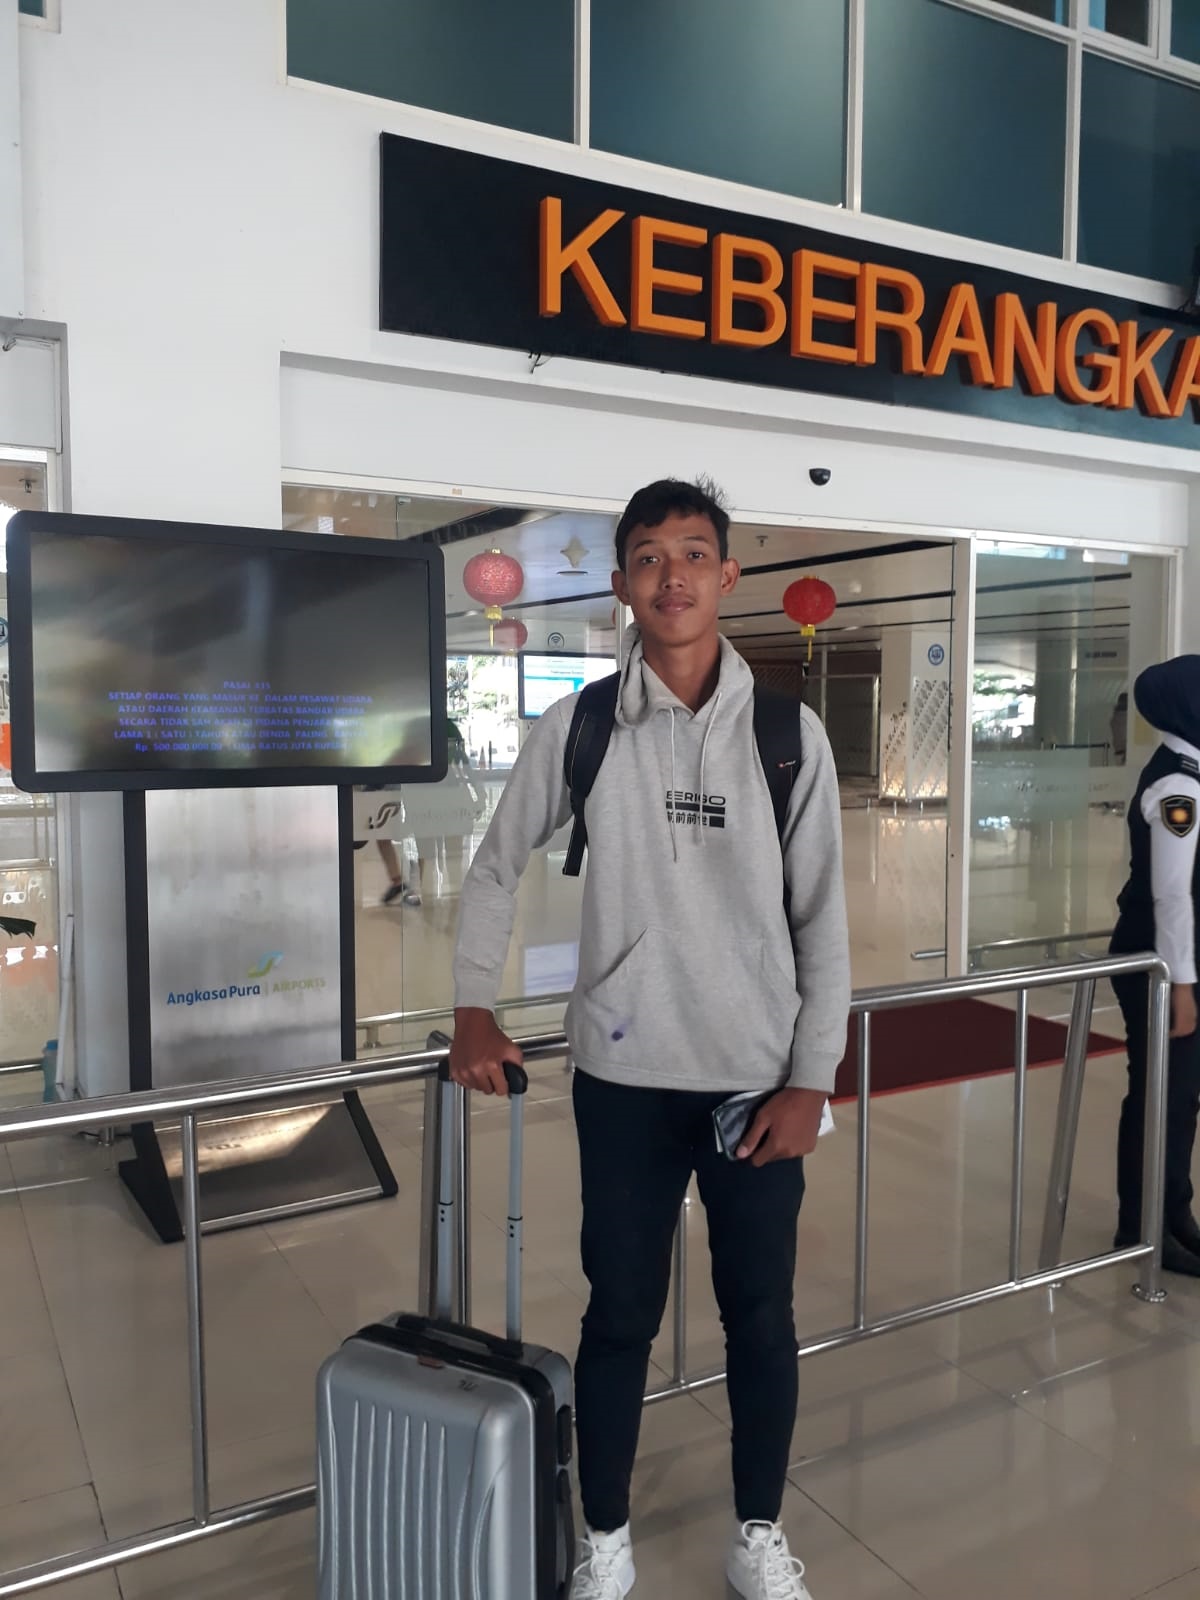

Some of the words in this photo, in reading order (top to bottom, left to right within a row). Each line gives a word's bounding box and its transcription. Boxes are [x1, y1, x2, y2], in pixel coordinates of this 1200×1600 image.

[144, 692, 181, 702] ORANG
[264, 694, 297, 704] DALAM
[113, 730, 144, 739] LAMA
[666, 790, 726, 806] ERIGO
[272, 977, 326, 993] AIRPORTS
